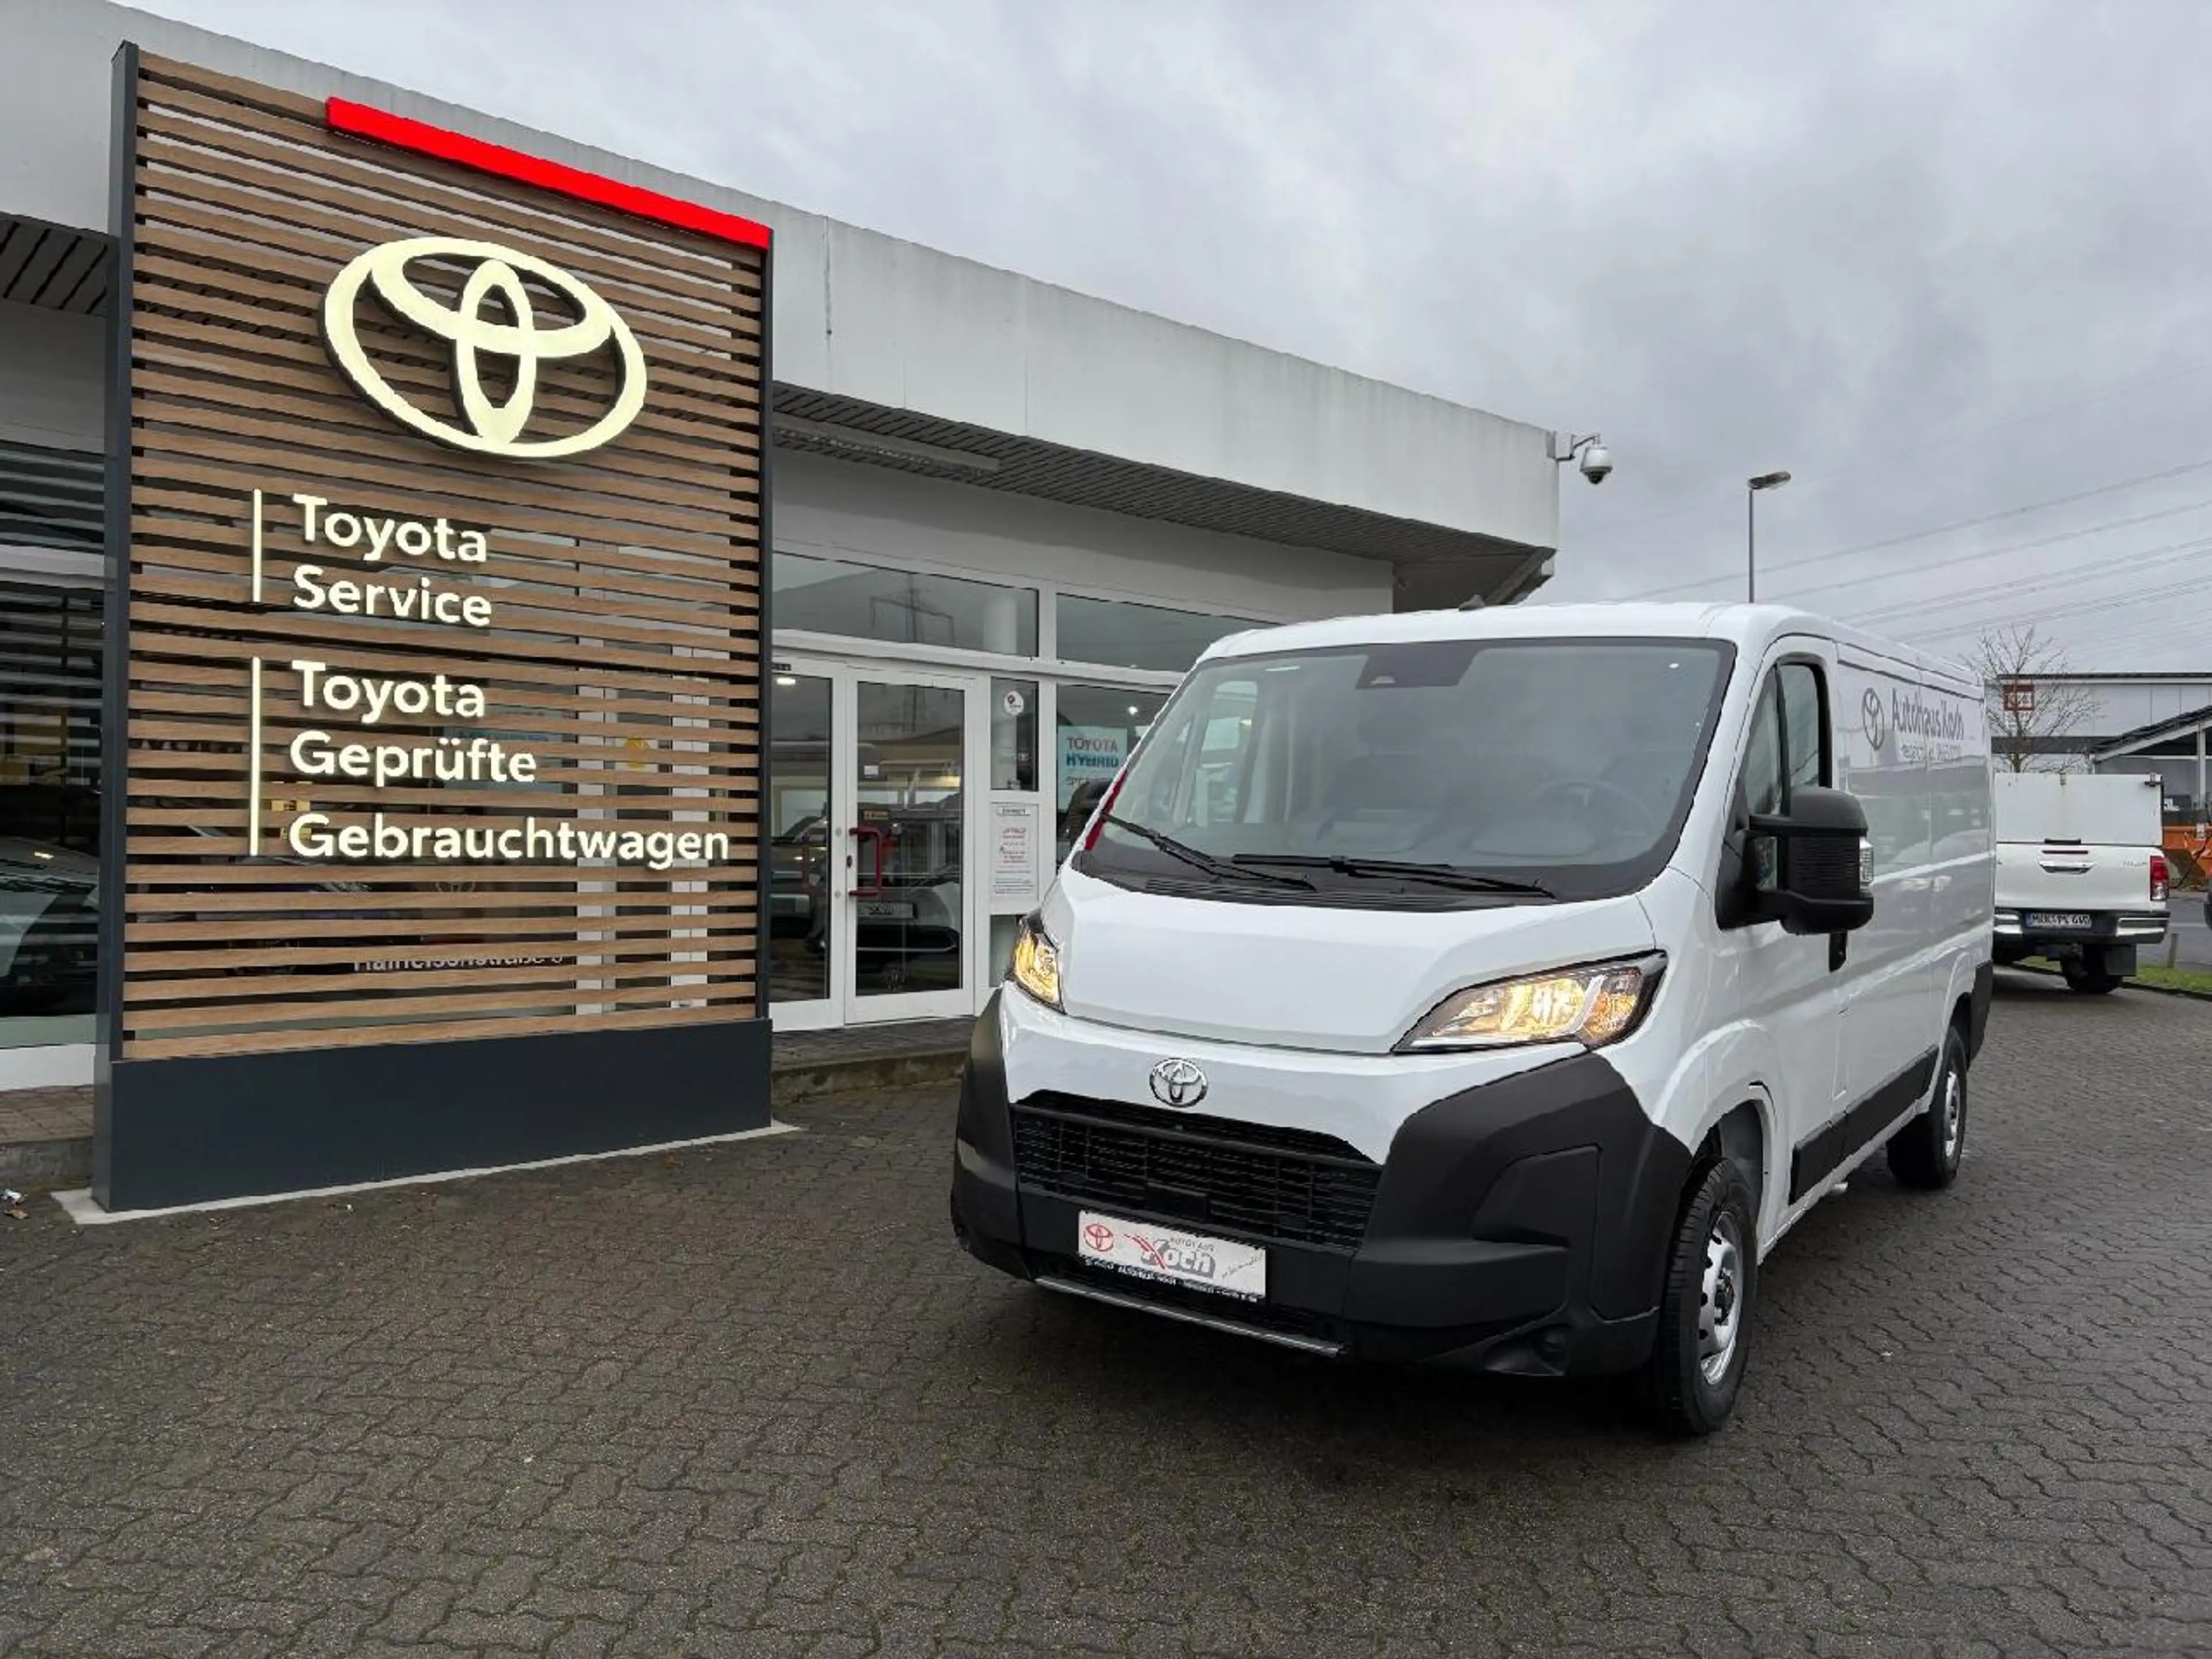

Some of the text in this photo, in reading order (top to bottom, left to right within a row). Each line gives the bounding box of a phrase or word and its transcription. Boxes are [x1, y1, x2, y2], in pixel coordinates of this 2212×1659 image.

[293, 494, 490, 562] Toyota
[293, 565, 492, 627] Service
[291, 660, 487, 724] Toyota
[290, 730, 537, 787] Geprüfte
[1065, 737, 1118, 752] TOYOTA
[1066, 752, 1119, 768] HYBRID
[289, 813, 729, 870] Gebrauchtwagen
